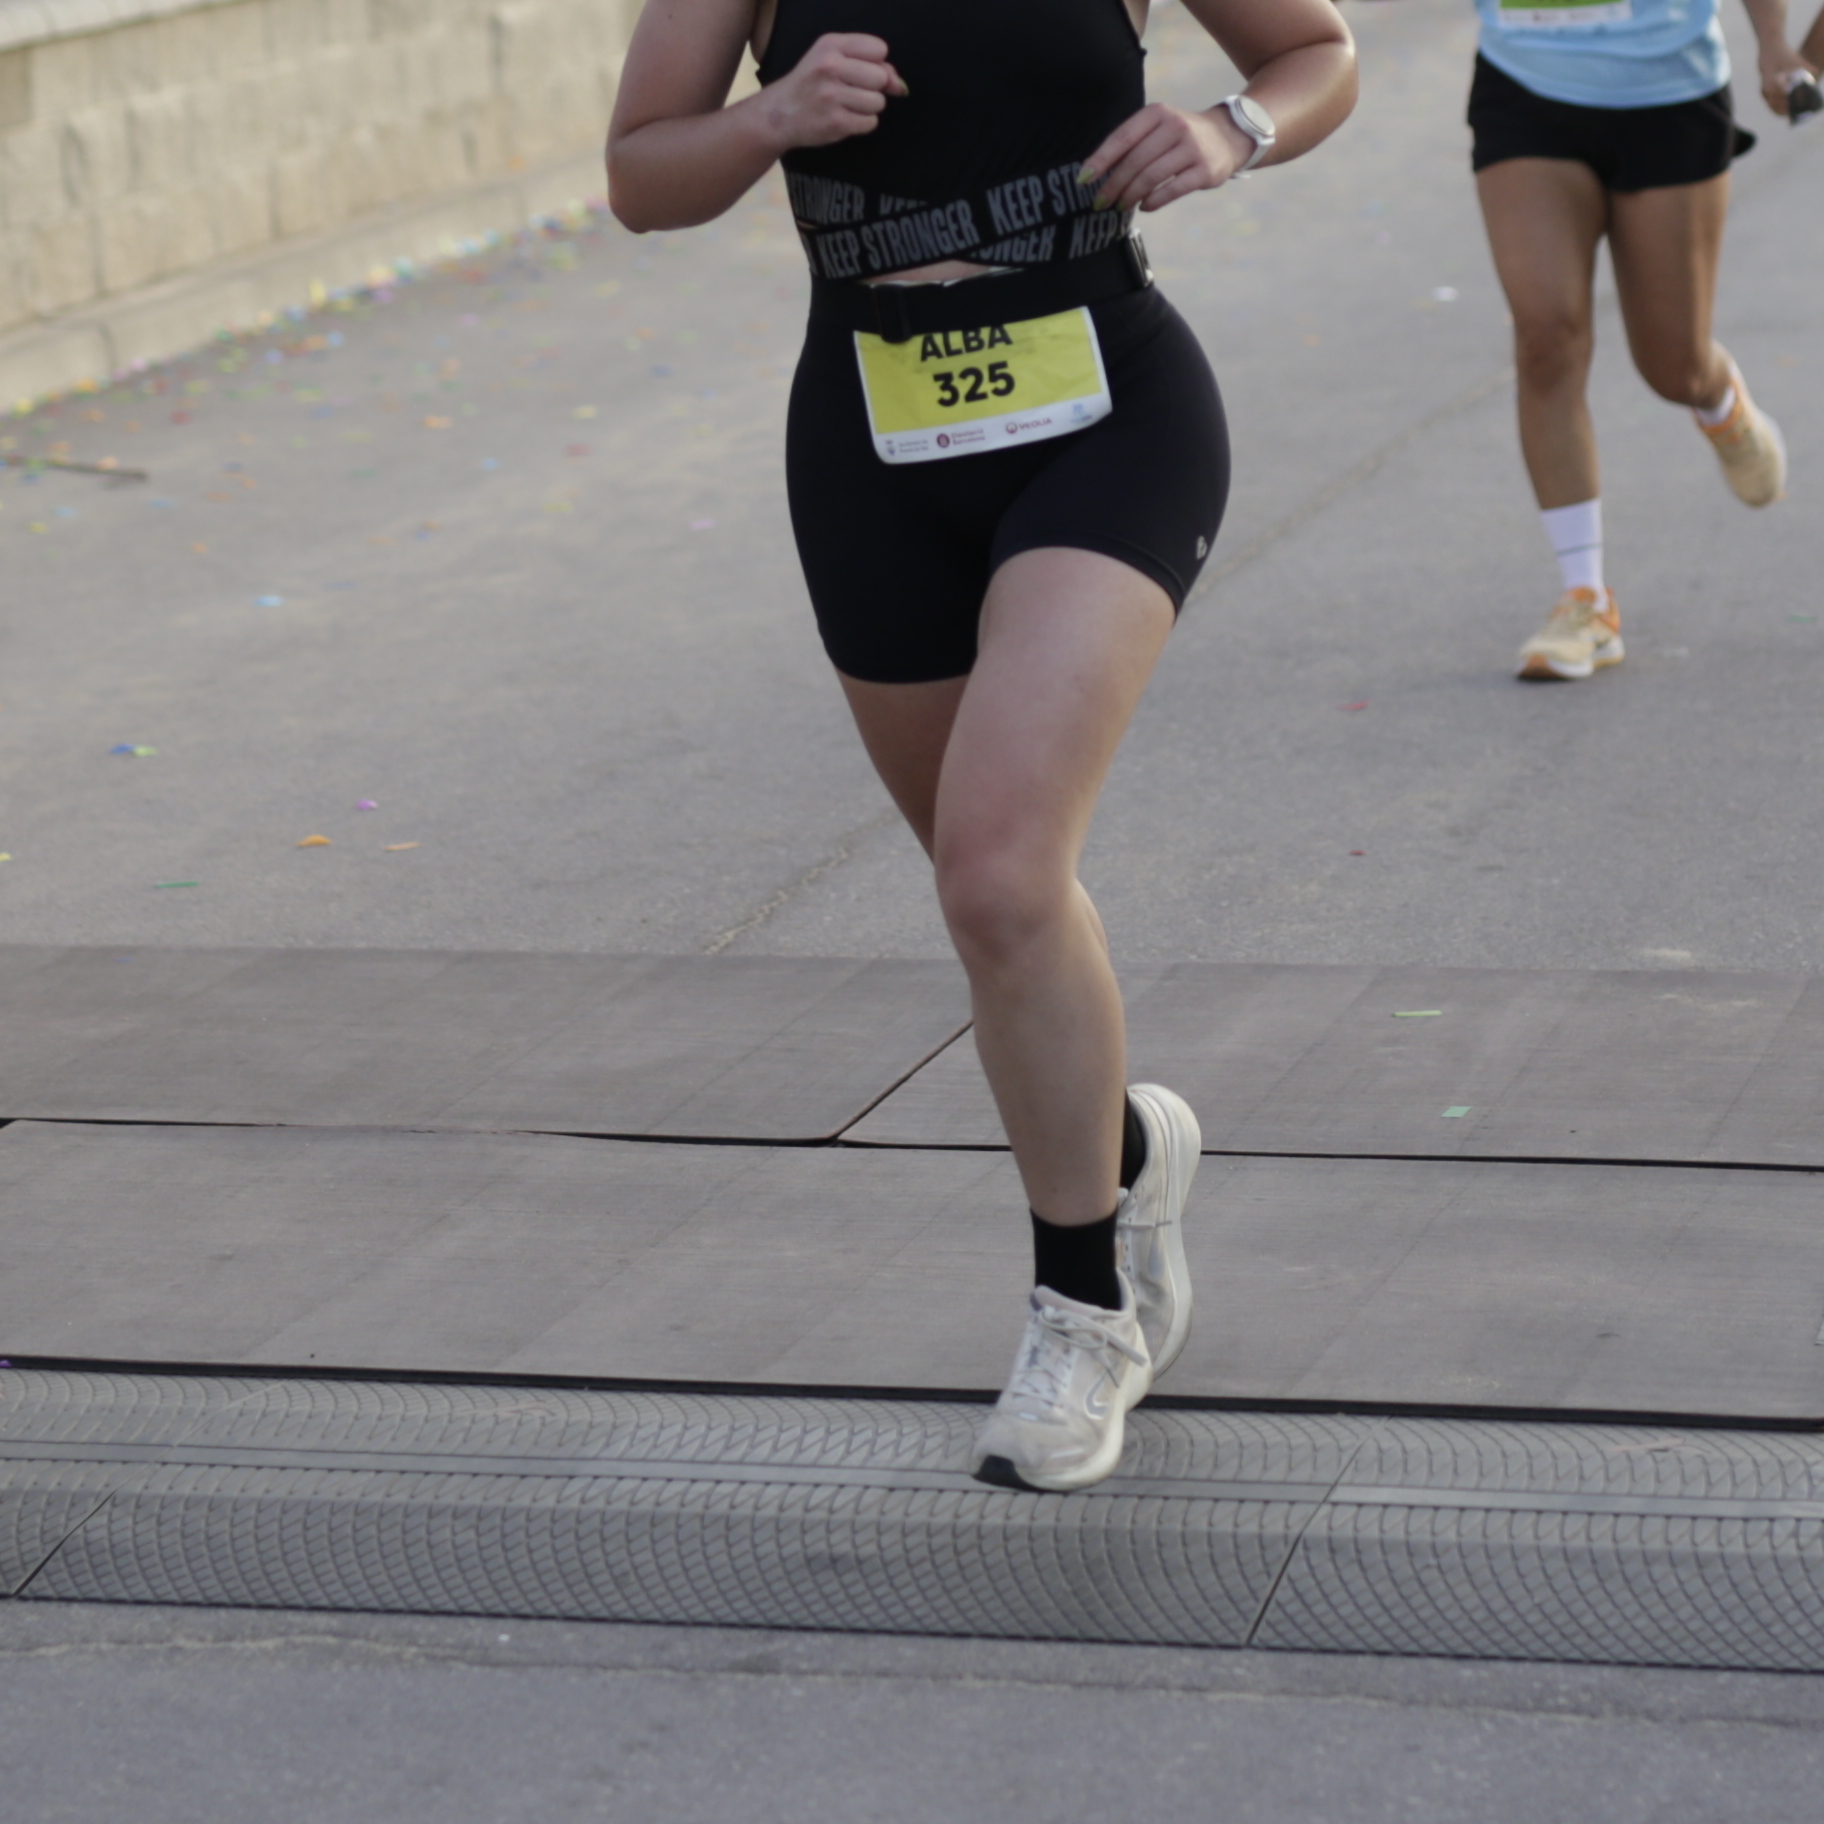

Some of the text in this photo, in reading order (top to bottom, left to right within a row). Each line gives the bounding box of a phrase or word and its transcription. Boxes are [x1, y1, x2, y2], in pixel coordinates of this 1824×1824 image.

[816, 228, 862, 279] KEEP
[860, 198, 981, 271] STRONGER
[986, 175, 1045, 236] KEEP
[1068, 210, 1118, 261] KEEP
[920, 324, 1014, 363] ALBA
[932, 360, 1016, 407] 325
